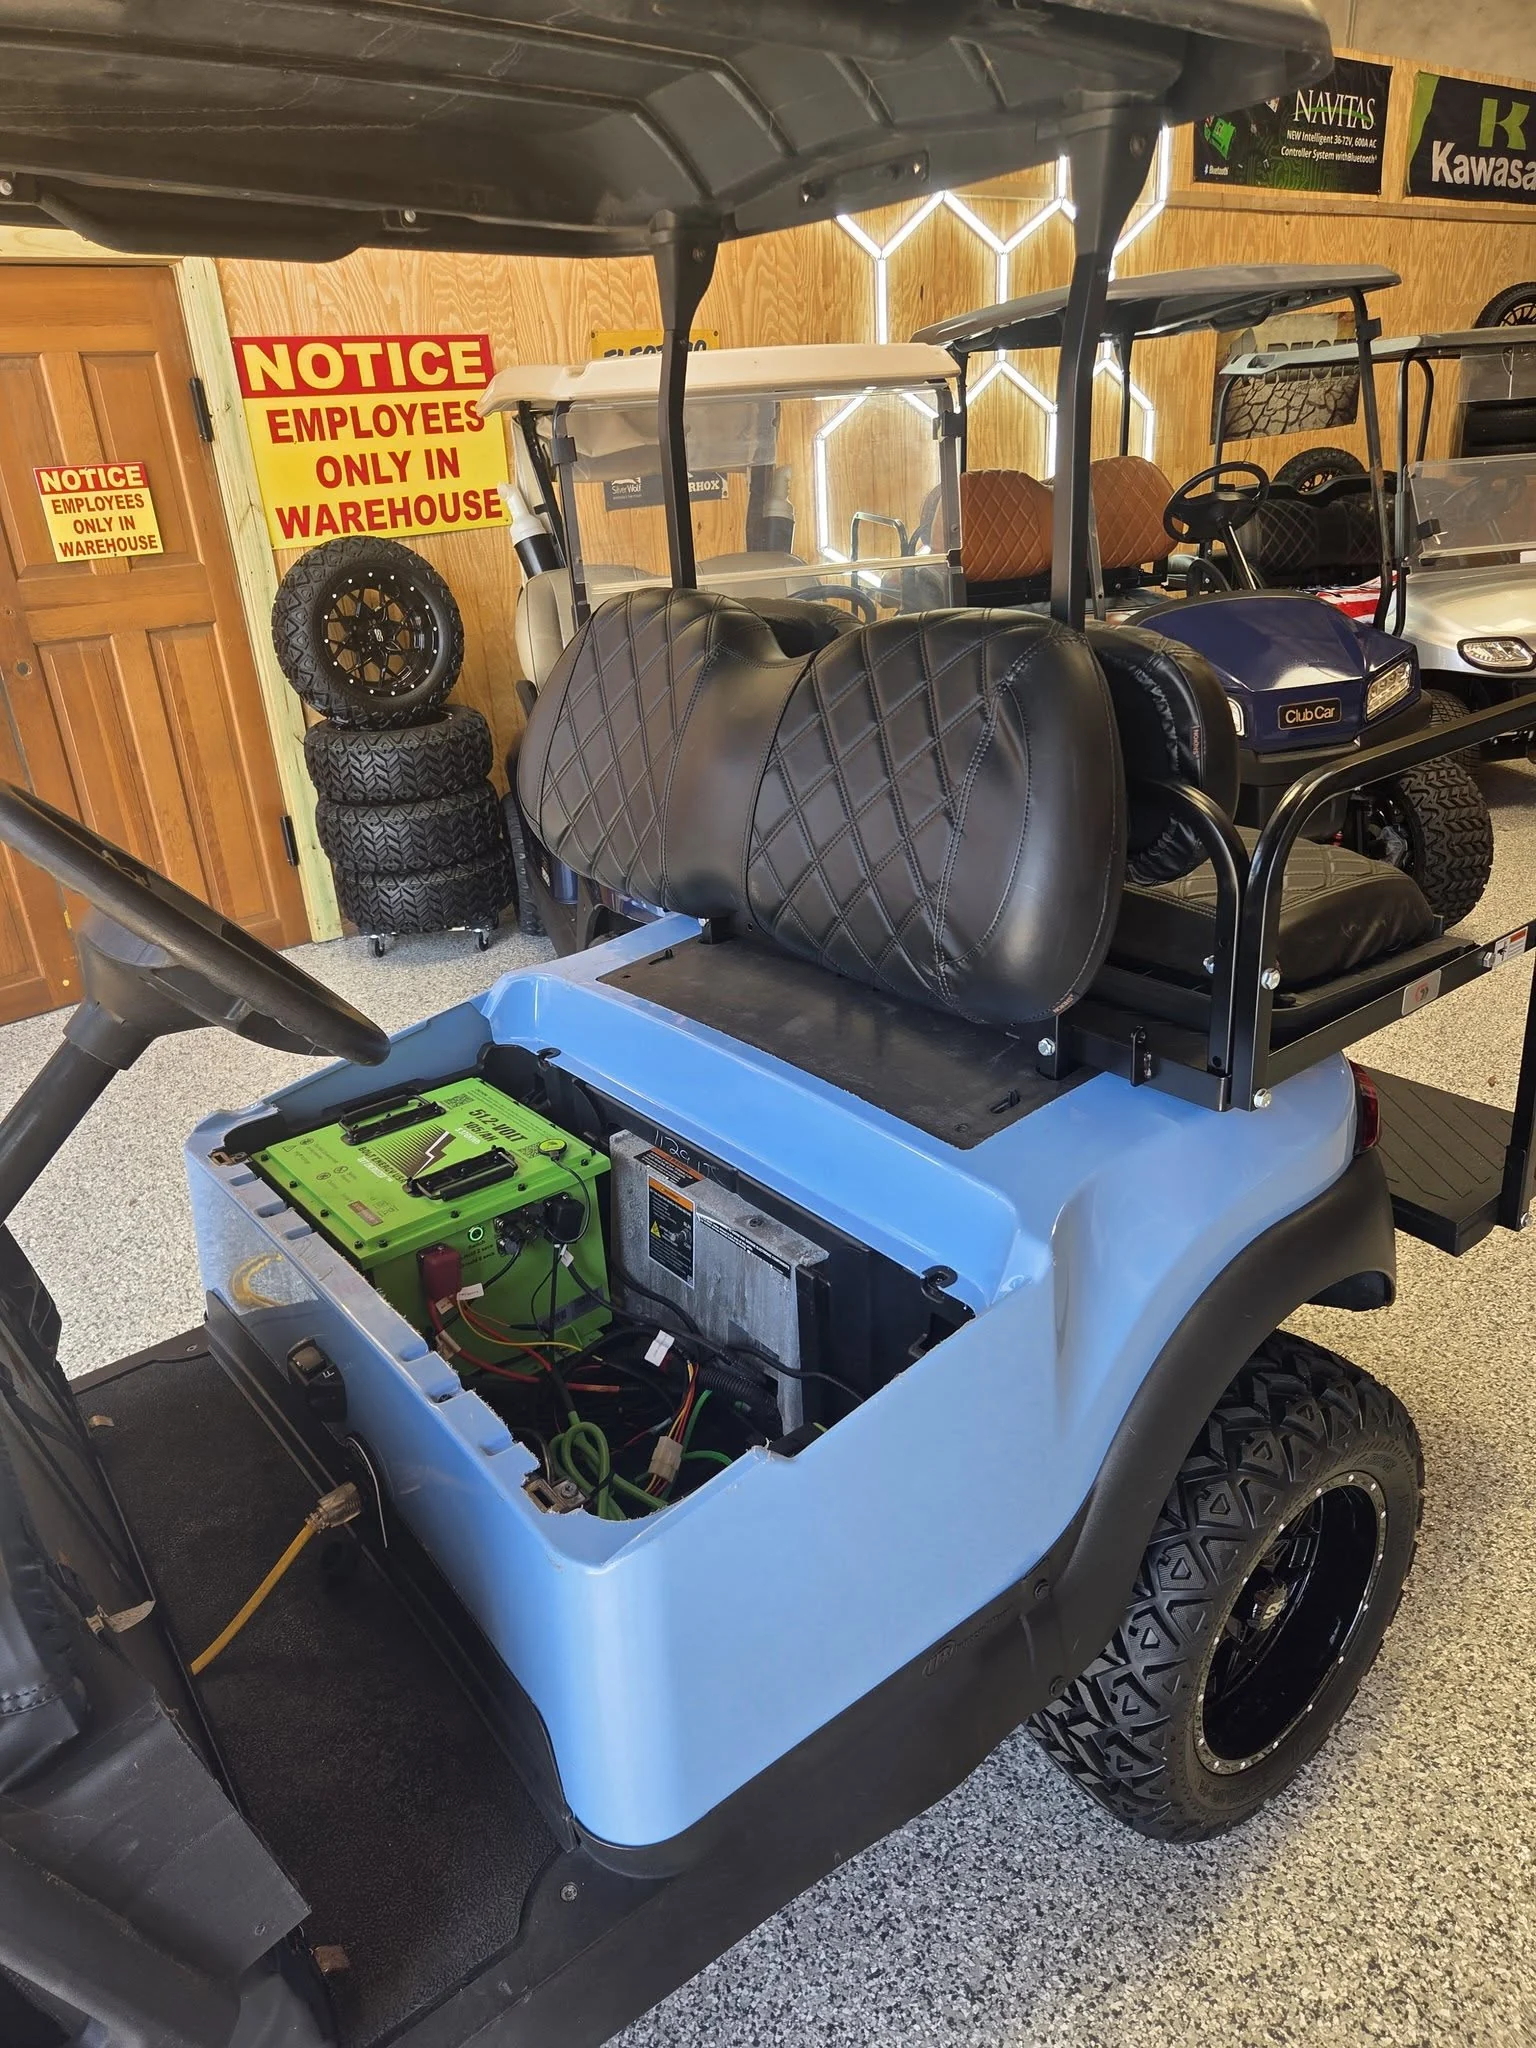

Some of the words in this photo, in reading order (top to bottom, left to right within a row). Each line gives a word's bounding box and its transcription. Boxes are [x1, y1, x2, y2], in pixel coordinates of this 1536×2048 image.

[1293, 88, 1376, 130] NAVITAS
[1286, 129, 1302, 141] NEW
[1302, 131, 1333, 146] Intelligent
[1369, 139, 1377, 149] AC
[1281, 146, 1312, 158] Controller
[1312, 149, 1335, 162] System
[1431, 140, 1536, 191] Kawasa
[242, 341, 487, 392] NOTICE
[266, 400, 485, 444] EMPLOYEES
[40, 465, 144, 492] NOTICE
[316, 450, 412, 489] ONLY
[424, 447, 461, 481] IN
[688, 480, 720, 493] RHOX
[51, 493, 145, 515] EMPLOYEES
[275, 488, 503, 540] WAREHOUSE
[73, 516, 113, 535] ONLY
[118, 515, 136, 531] IN
[58, 535, 158, 558] WAREHOUSE
[1285, 708, 1314, 724] Club
[1314, 705, 1336, 720] Car
[463, 1121, 500, 1142] 105/AH
[468, 1108, 529, 1142] 51.2-VOLT
[371, 1156, 399, 1175] ENERGY
[322, 1370, 335, 1379] F
